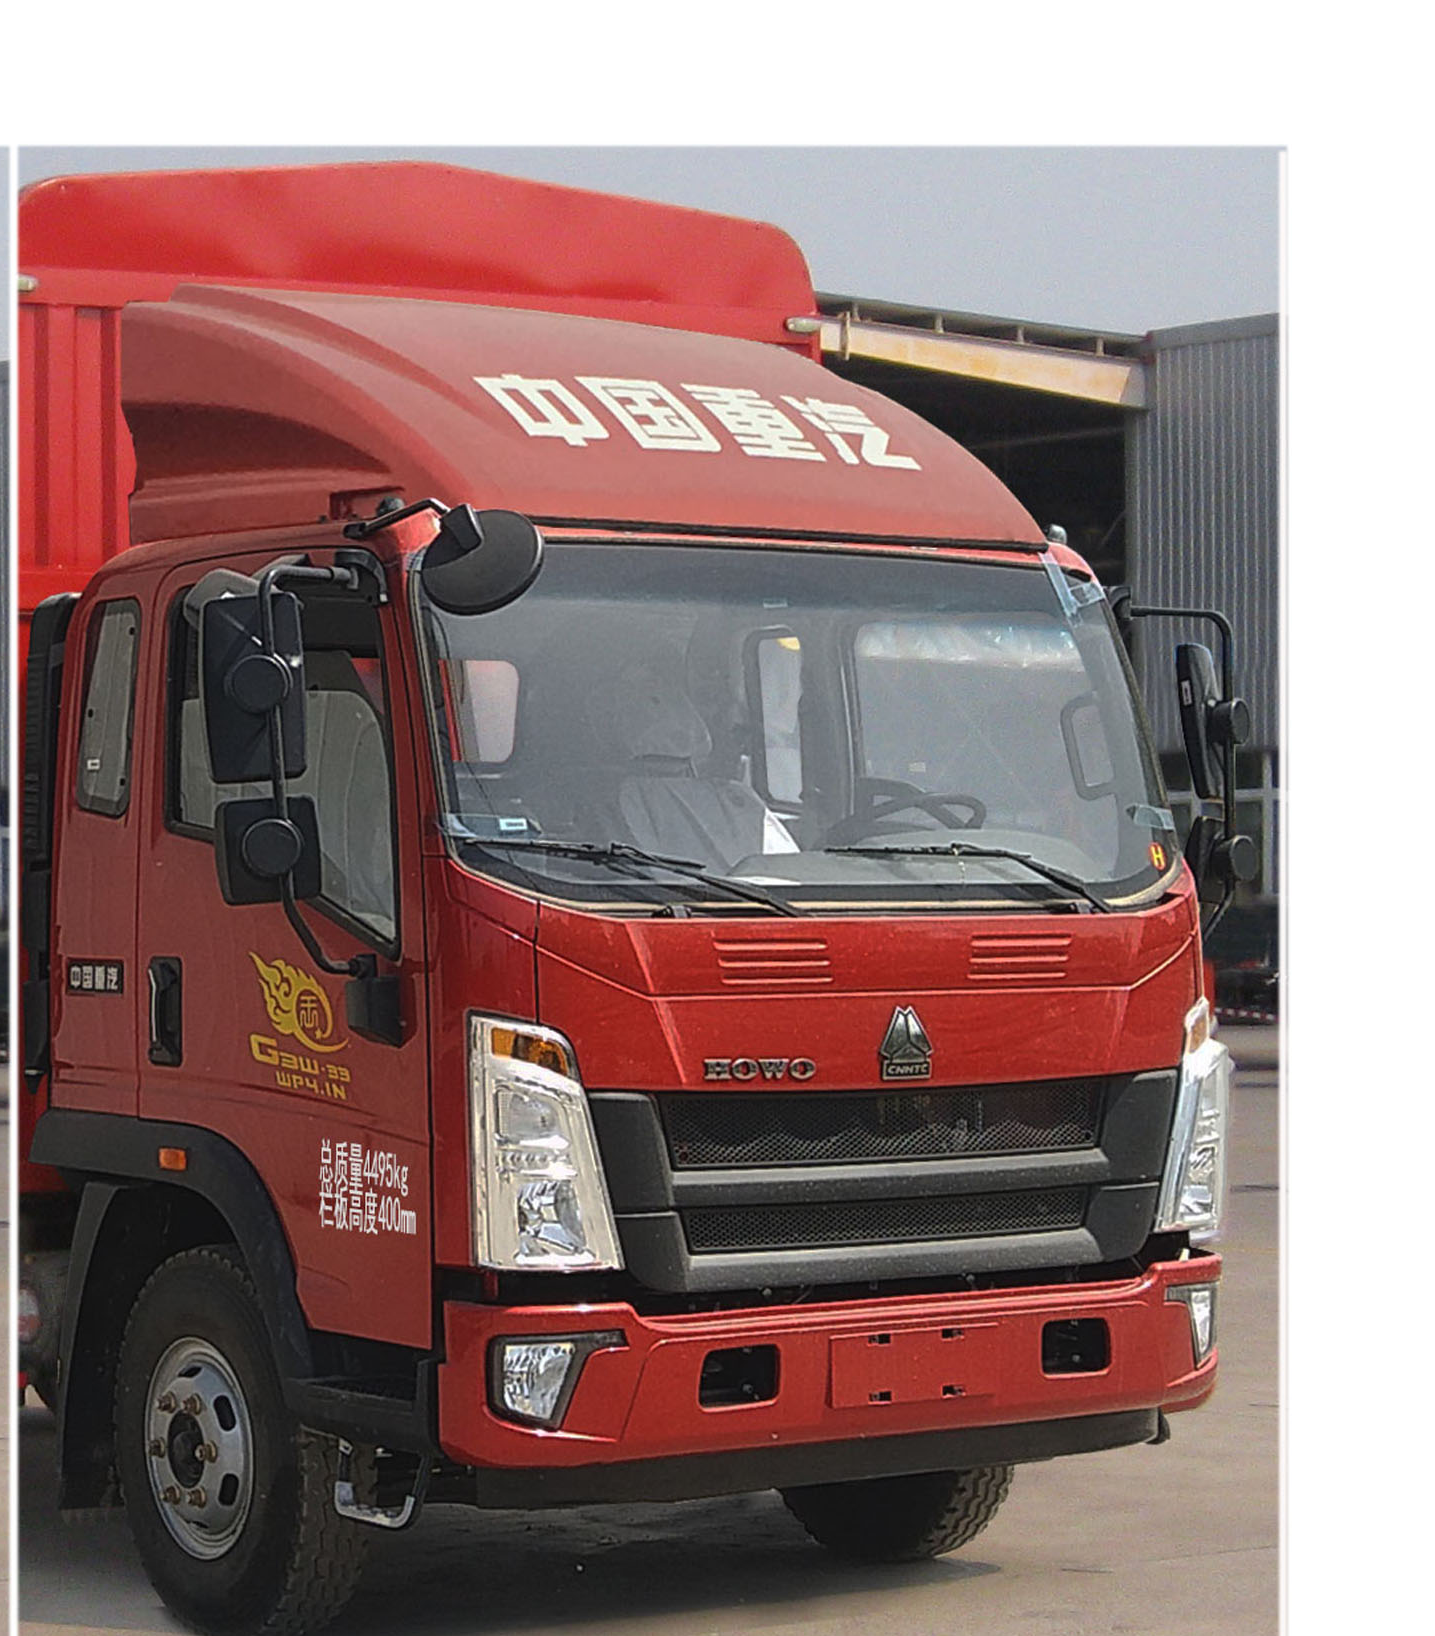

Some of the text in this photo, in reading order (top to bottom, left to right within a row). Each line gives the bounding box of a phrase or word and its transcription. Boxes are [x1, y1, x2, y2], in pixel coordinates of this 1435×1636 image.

[472, 374, 922, 471] 中国重汽
[703, 1057, 816, 1081] HOWO
